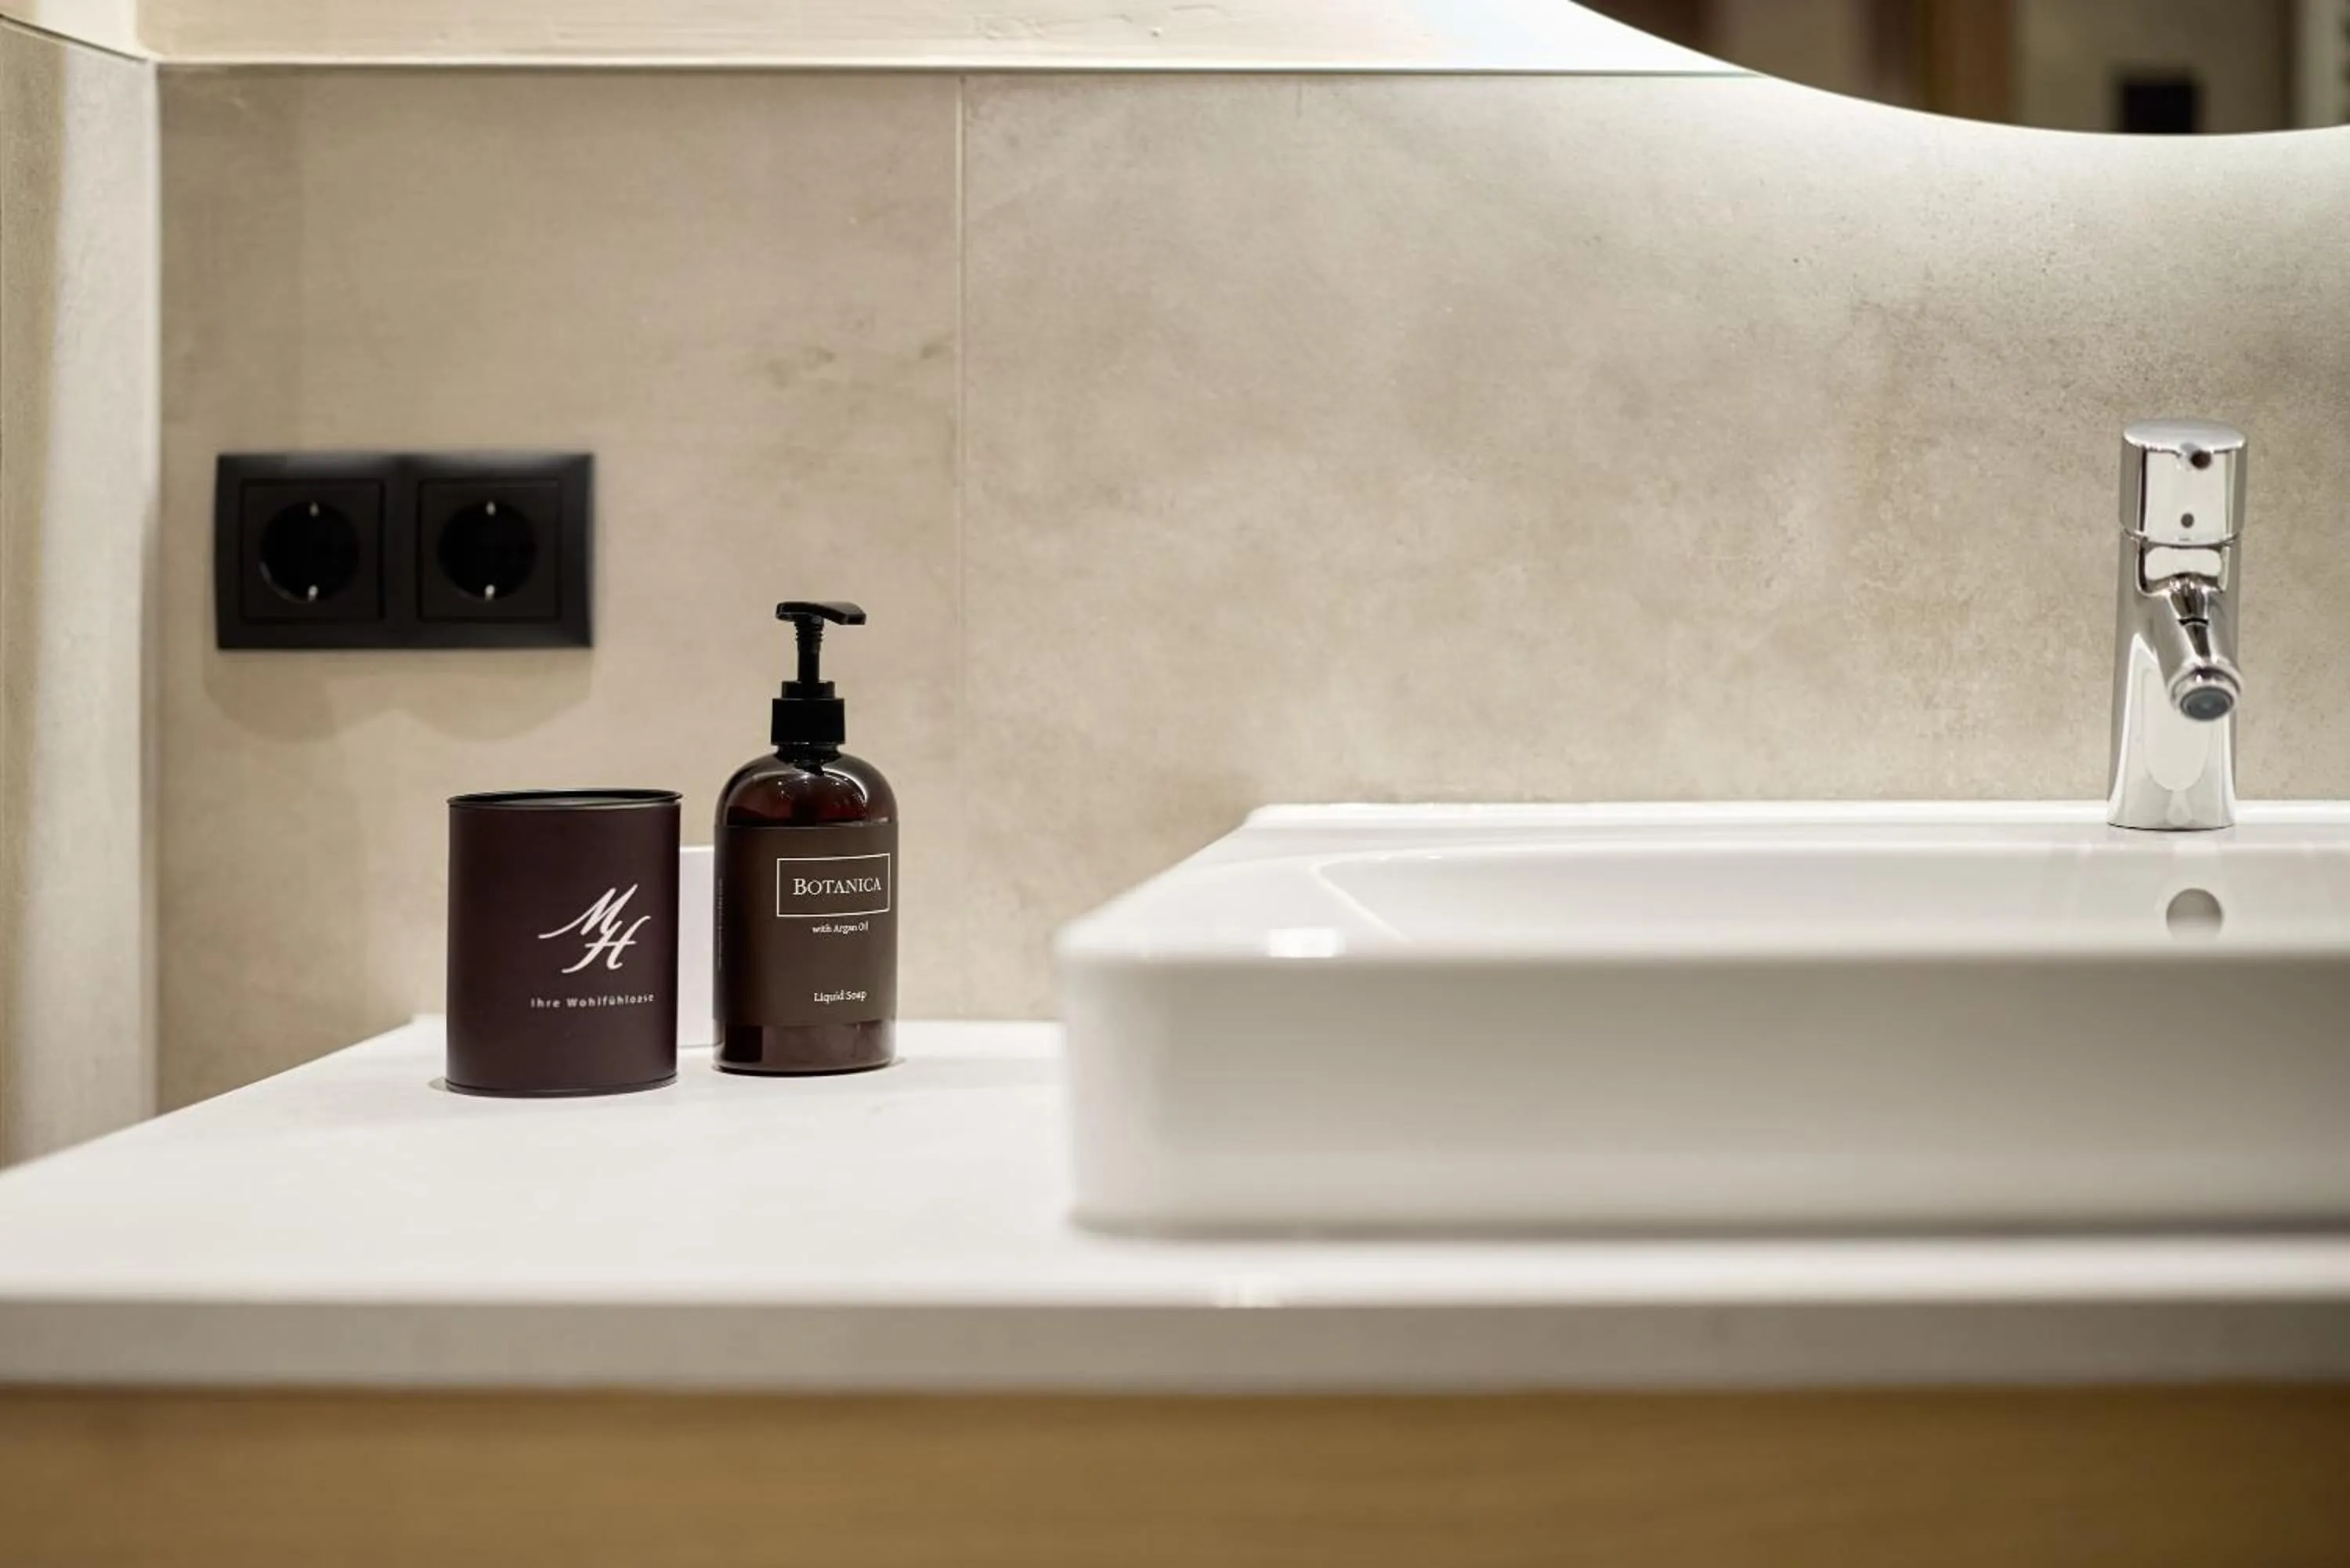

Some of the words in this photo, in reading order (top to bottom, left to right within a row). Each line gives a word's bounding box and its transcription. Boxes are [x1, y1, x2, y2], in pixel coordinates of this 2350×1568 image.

[812, 923, 832, 934] with
[833, 923, 858, 934] Argan
[859, 920, 869, 931] Oil
[530, 997, 561, 1007] Ihre
[566, 993, 654, 1007] Wohlfühloase
[813, 989, 844, 1004] Liquid
[845, 990, 867, 1002] Soap
